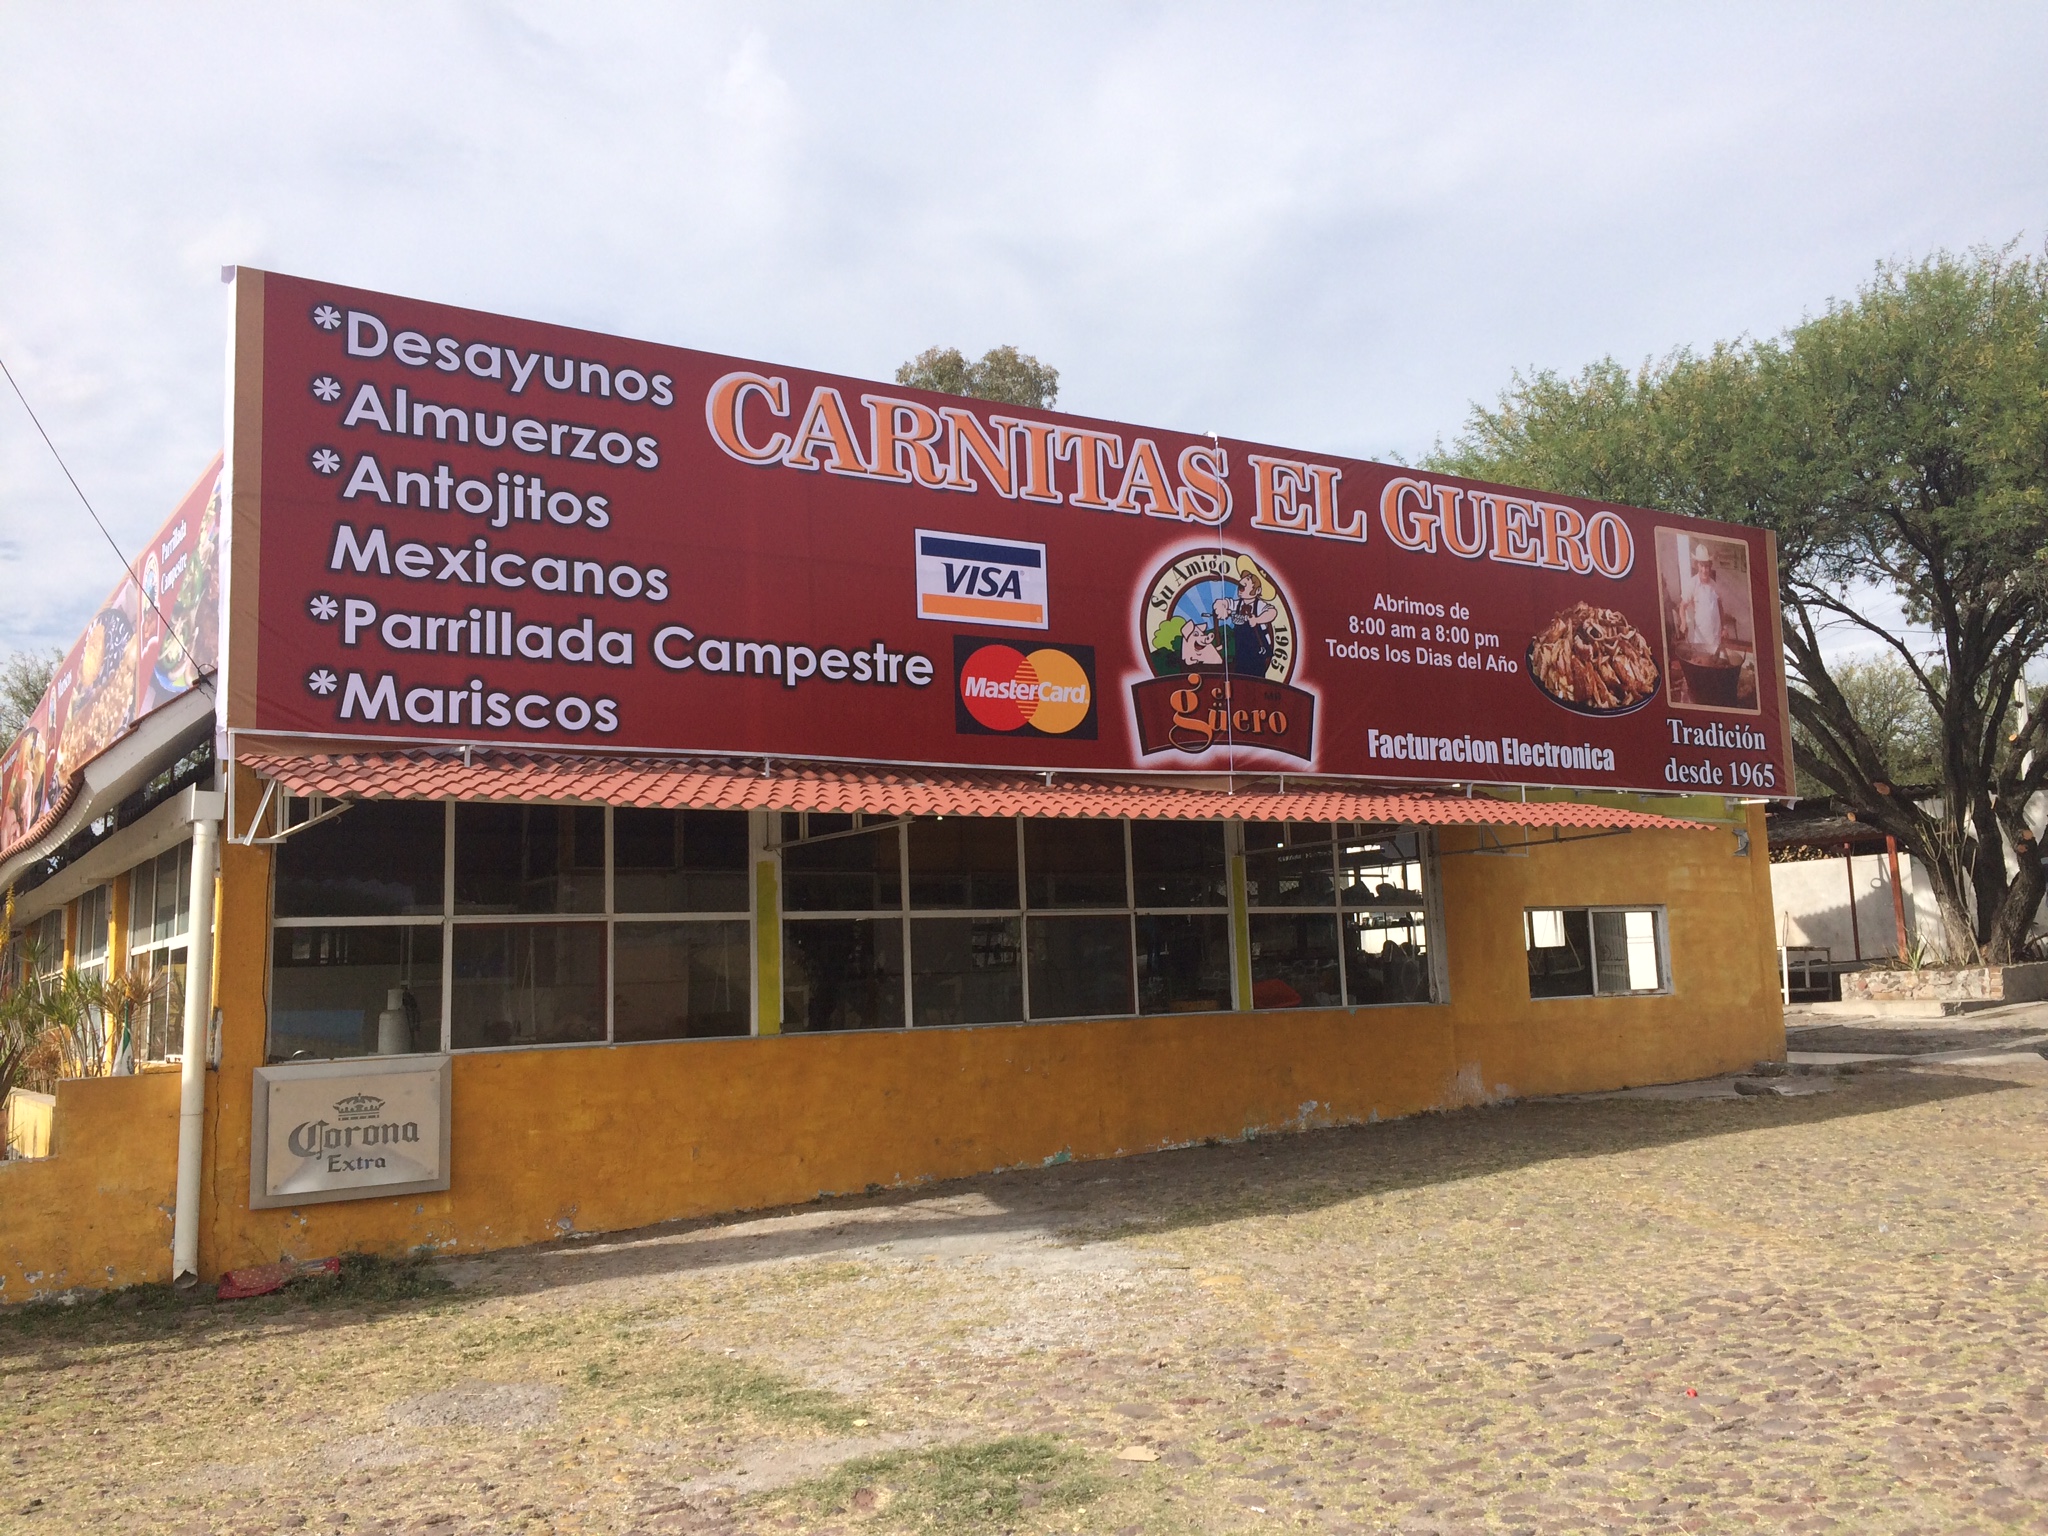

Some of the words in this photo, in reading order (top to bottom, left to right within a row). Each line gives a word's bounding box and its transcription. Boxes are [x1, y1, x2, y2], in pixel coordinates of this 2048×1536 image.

[705, 371, 1235, 526] CARNITAS
[1248, 454, 1368, 543] EL
[1380, 477, 1635, 579] GUERO
[330, 525, 669, 601] Mexicanos
[941, 562, 1022, 600] VISA
[1150, 589, 1175, 613] Su
[1172, 554, 1230, 587] Amigo
[1373, 593, 1445, 618] Abrimos
[1450, 602, 1470, 621] de
[1270, 625, 1290, 674] 1965
[1349, 616, 1385, 636] 8:00
[1391, 622, 1416, 639] am
[1421, 627, 1431, 641] a
[1435, 624, 1469, 645] 8:00
[1474, 632, 1499, 650] pm
[654, 626, 934, 686] Campestre
[1325, 638, 1380, 661] Todos
[1385, 644, 1411, 664] los
[1416, 647, 1452, 667] Dias
[1457, 651, 1482, 670] del
[1486, 655, 1518, 674] Año
[965, 676, 1087, 704] MasterCard
[1168, 673, 1287, 751] güero
[1367, 728, 1499, 764] Facturacion
[1501, 737, 1615, 771] Electronica
[1666, 718, 1767, 750] Tradición
[1664, 757, 1723, 785] desde
[1729, 761, 1775, 788] 1965
[288, 1119, 420, 1160] Corona
[326, 1154, 387, 1173] Extra
